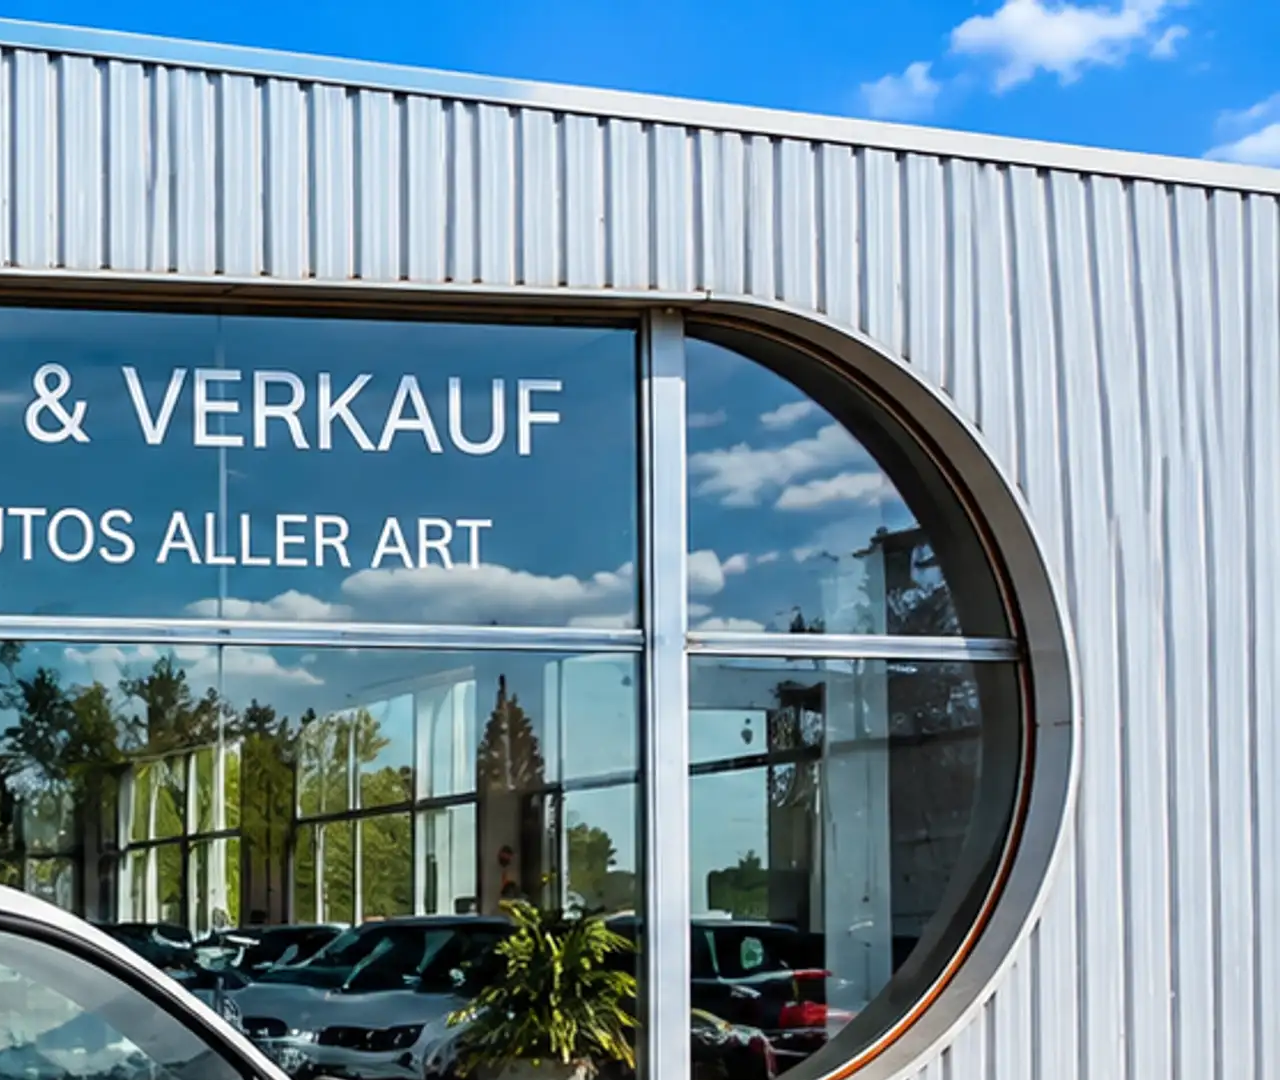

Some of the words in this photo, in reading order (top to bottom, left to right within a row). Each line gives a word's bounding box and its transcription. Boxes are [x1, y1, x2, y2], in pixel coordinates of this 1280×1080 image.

[25, 362, 91, 444] &
[122, 365, 563, 456] VERKAUF
[155, 510, 352, 569] ALLER
[370, 516, 494, 570] ART
